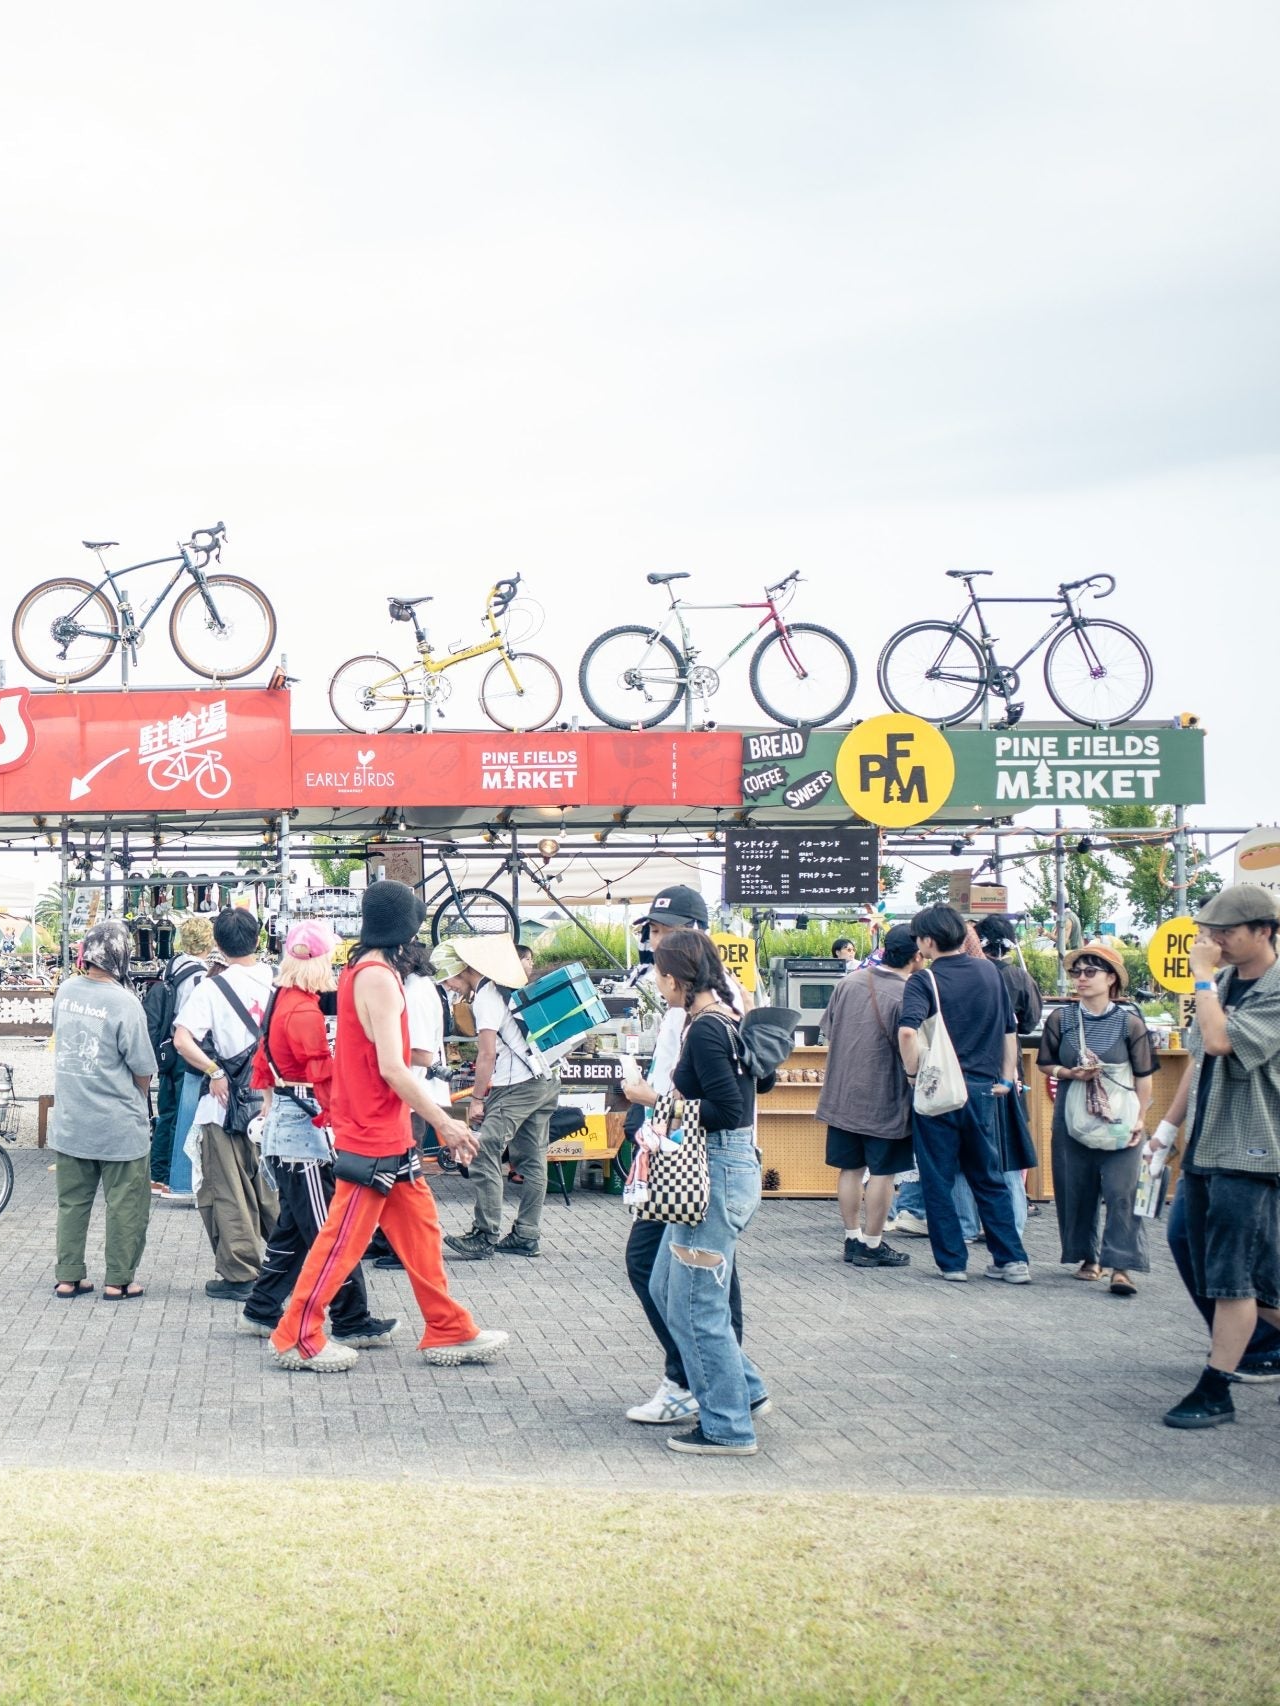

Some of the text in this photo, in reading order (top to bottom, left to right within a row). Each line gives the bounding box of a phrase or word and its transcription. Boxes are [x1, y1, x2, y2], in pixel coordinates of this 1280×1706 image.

[138, 699, 227, 757] 駐輪場
[749, 731, 804, 760] BREAD
[995, 735, 1160, 757] PINE FIELDS
[482, 750, 578, 764] PINE FIELDS
[306, 771, 395, 787] EARLY BIRDS
[743, 766, 785, 795] COFFEE
[786, 770, 833, 810] SWEETS
[800, 886, 856, 894] コールスローサラダ
[717, 944, 749, 962] DER
[1167, 933, 1197, 954] PIC
[1164, 956, 1196, 978] HER
[70, 1000, 84, 1014] the
[84, 1003, 108, 1018] hook
[558, 1064, 582, 1078] EER
[584, 1064, 612, 1078] BEER
